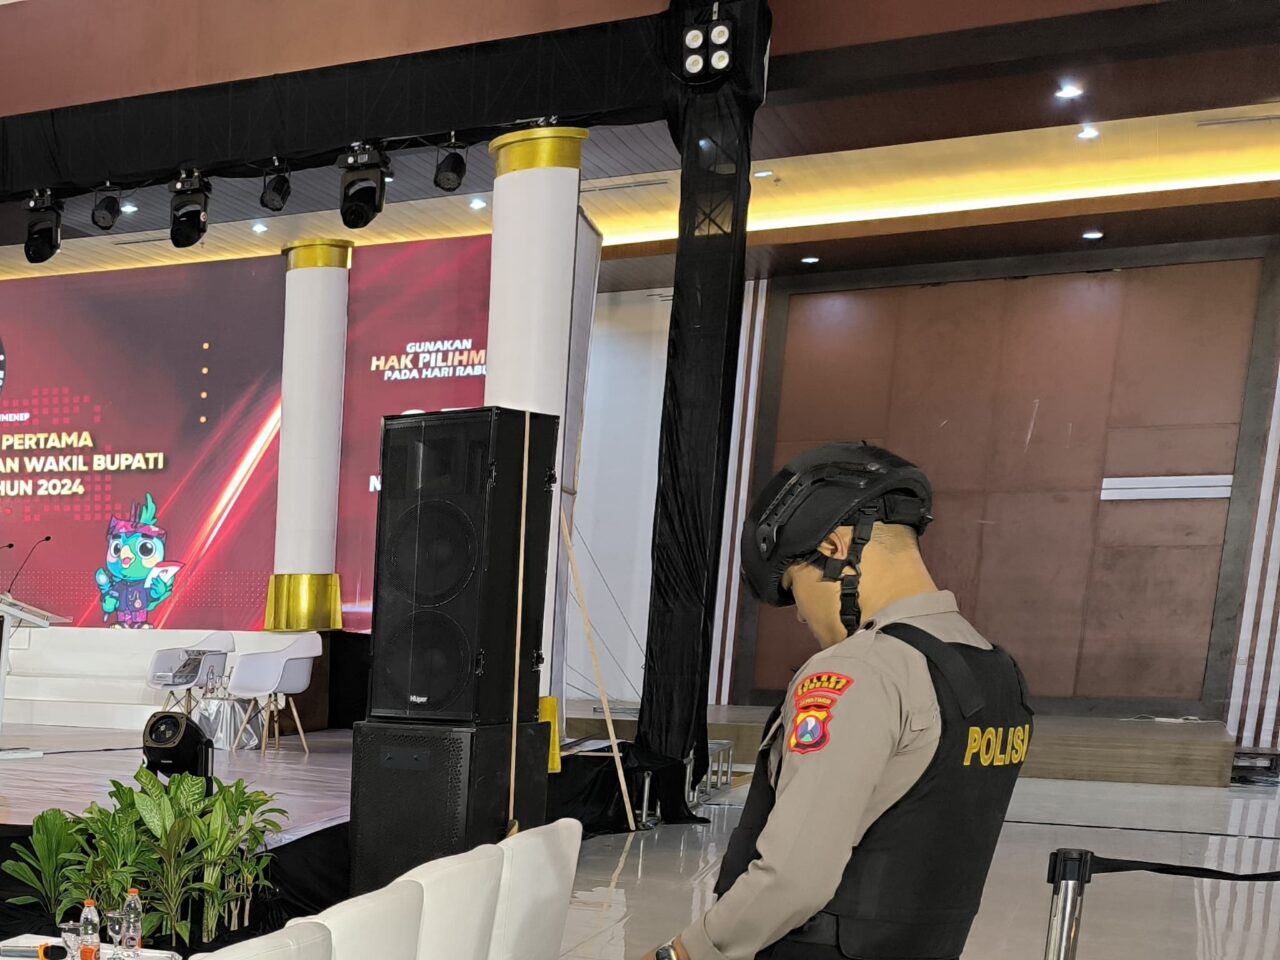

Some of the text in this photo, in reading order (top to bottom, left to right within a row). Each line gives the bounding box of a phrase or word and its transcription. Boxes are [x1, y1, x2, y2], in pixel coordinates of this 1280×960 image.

[406, 339, 472, 353] GUNAKAN
[370, 354, 414, 371] HAK
[384, 370, 419, 380] PADA
[421, 367, 454, 378] HARI
[1, 431, 94, 450] PERTAMA
[23, 454, 89, 473] WAKIL
[92, 452, 164, 471] BUPATI
[36, 478, 85, 496] 2024
[963, 724, 1030, 767] POLISI
